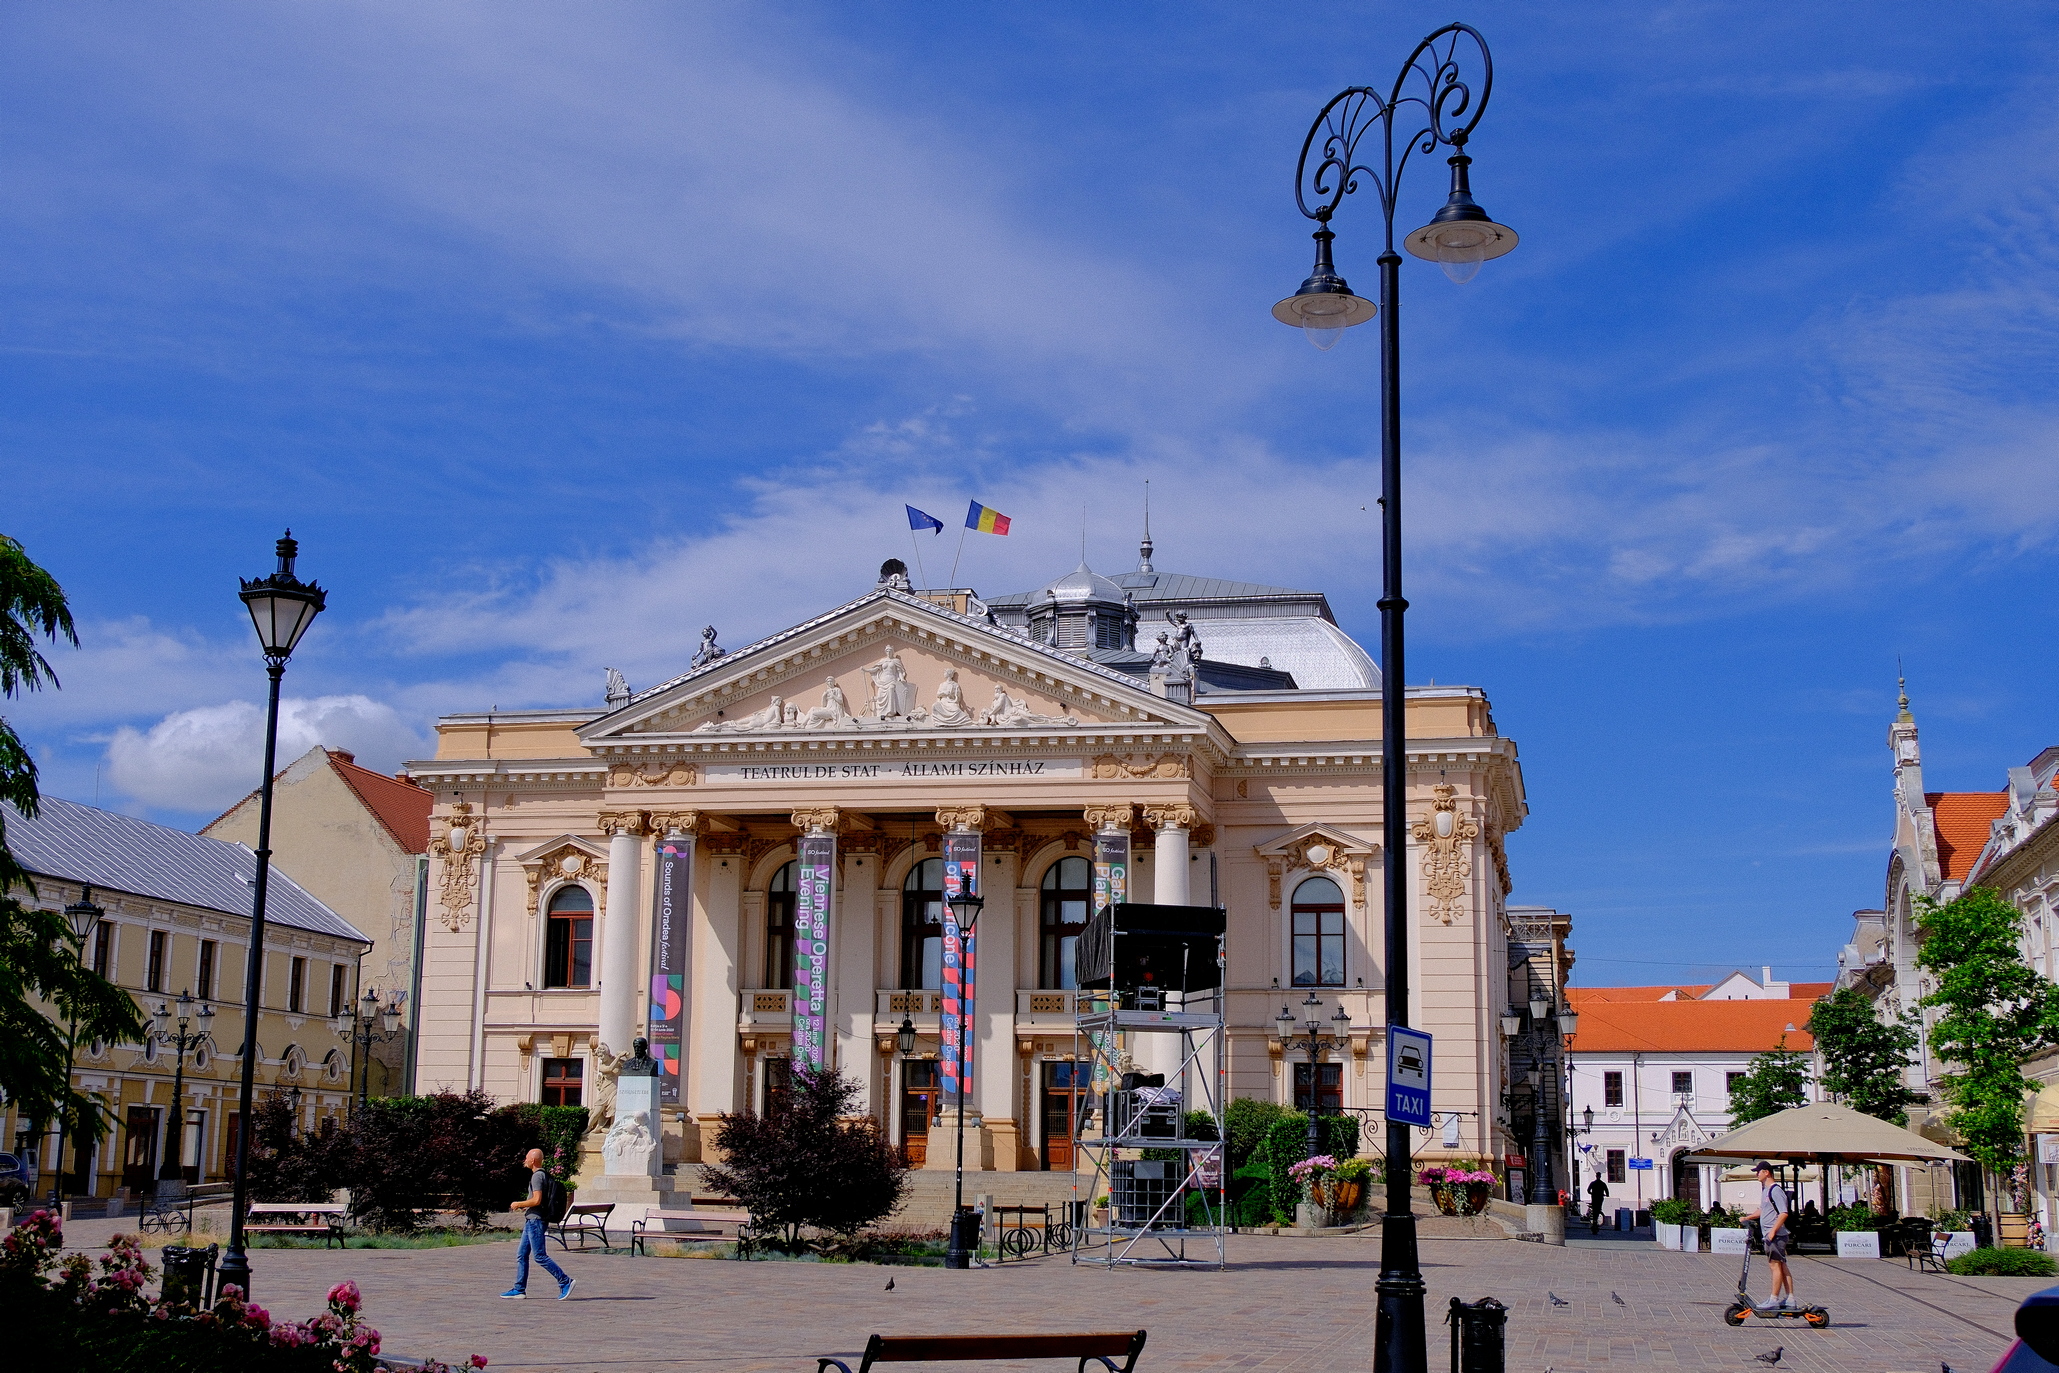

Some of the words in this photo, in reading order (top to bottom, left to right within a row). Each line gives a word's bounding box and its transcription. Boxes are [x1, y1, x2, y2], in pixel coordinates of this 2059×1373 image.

[741, 766, 811, 779] TEATRUL
[815, 766, 837, 778] DE
[841, 765, 880, 778] STAT
[901, 761, 964, 777] ÁLLAMI
[968, 759, 1045, 776] SZÍNHÁZ
[663, 861, 674, 896] Sounds
[946, 864, 960, 881] of
[795, 868, 815, 930] Evening
[1095, 866, 1110, 910] Piano
[663, 897, 672, 909] of
[813, 867, 830, 939] Viennese
[662, 908, 672, 940] Oradea
[945, 884, 960, 964] Mrricone
[660, 939, 671, 971] festival
[809, 942, 827, 1011] Operetta
[797, 1018, 805, 1045] Cetatea
[812, 1018, 819, 1027] 12
[811, 1044, 819, 1064] 2026
[1395, 1093, 1424, 1116] TAXI
